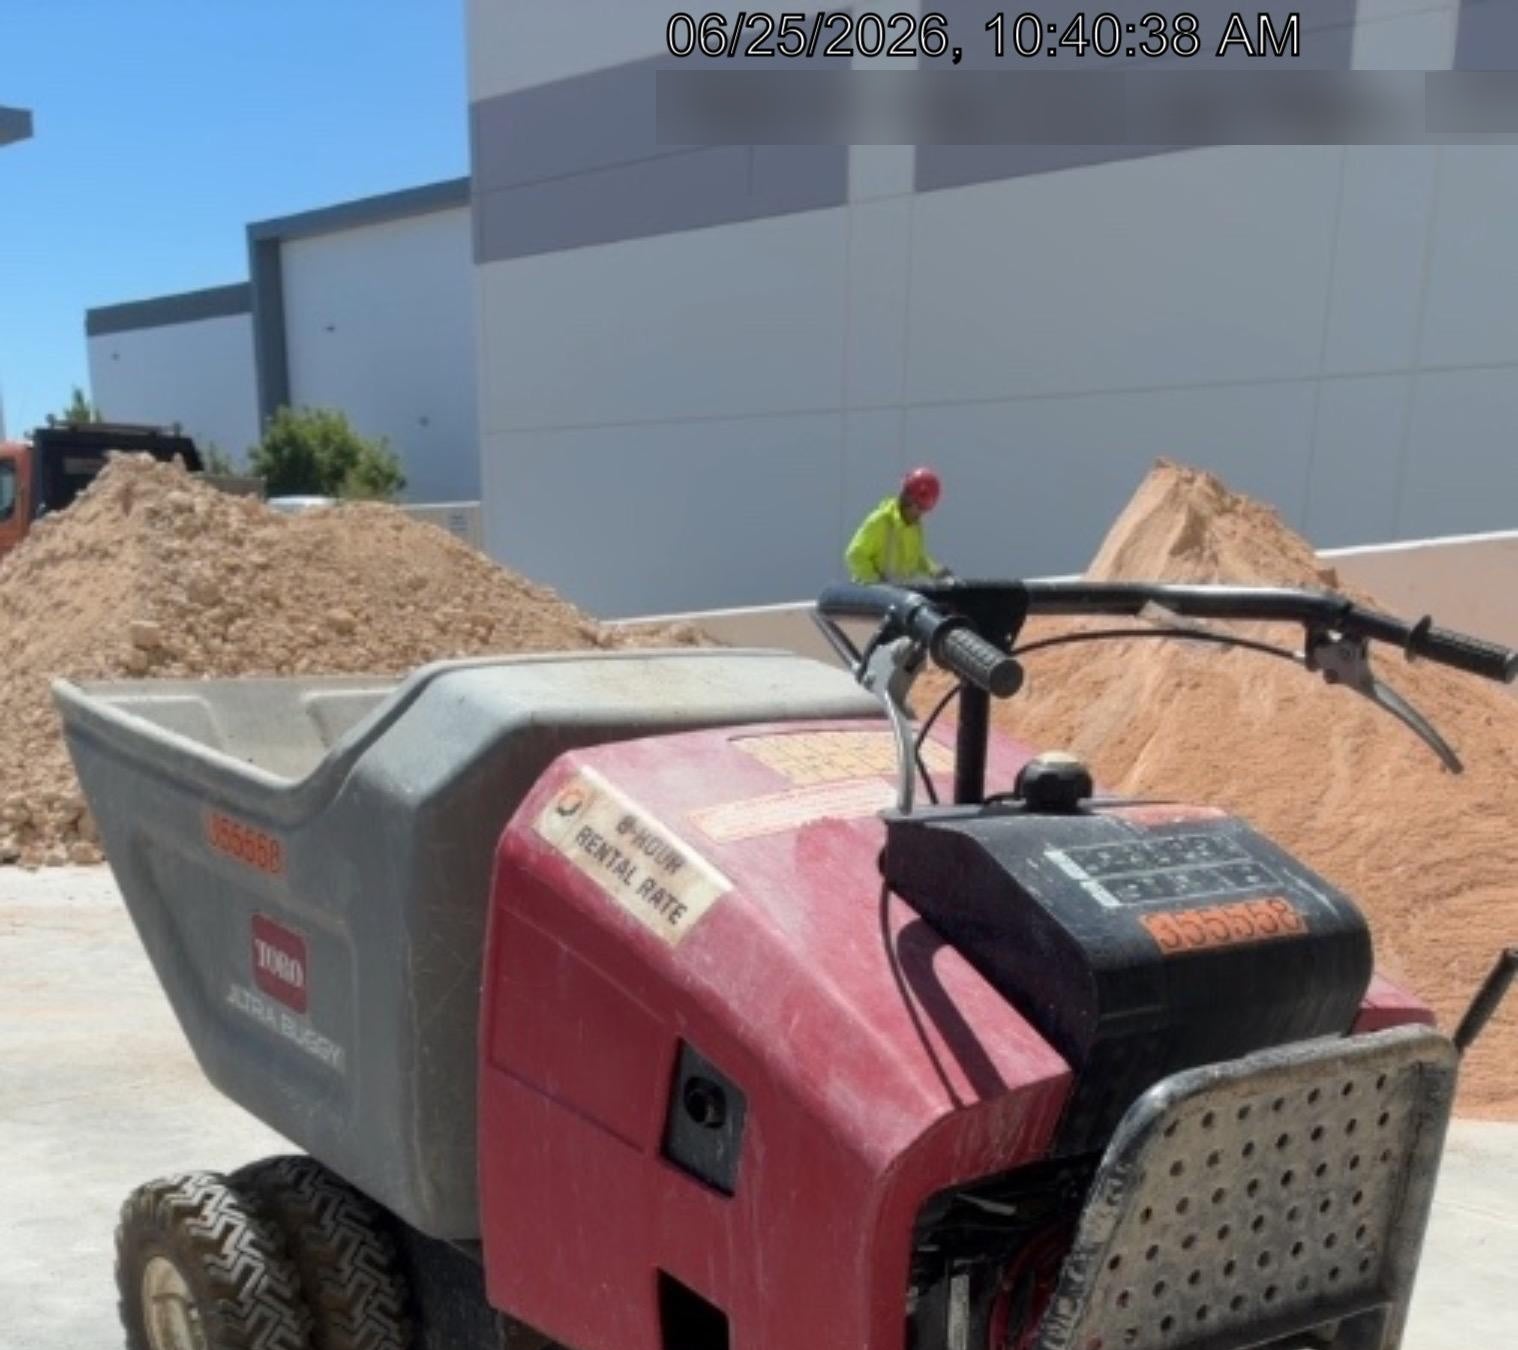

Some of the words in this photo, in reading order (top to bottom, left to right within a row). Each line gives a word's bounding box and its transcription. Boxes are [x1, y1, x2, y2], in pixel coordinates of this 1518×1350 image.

[576, 825, 638, 887] RENTAL
[636, 877, 689, 926] RATE
[255, 938, 304, 988] TORO
